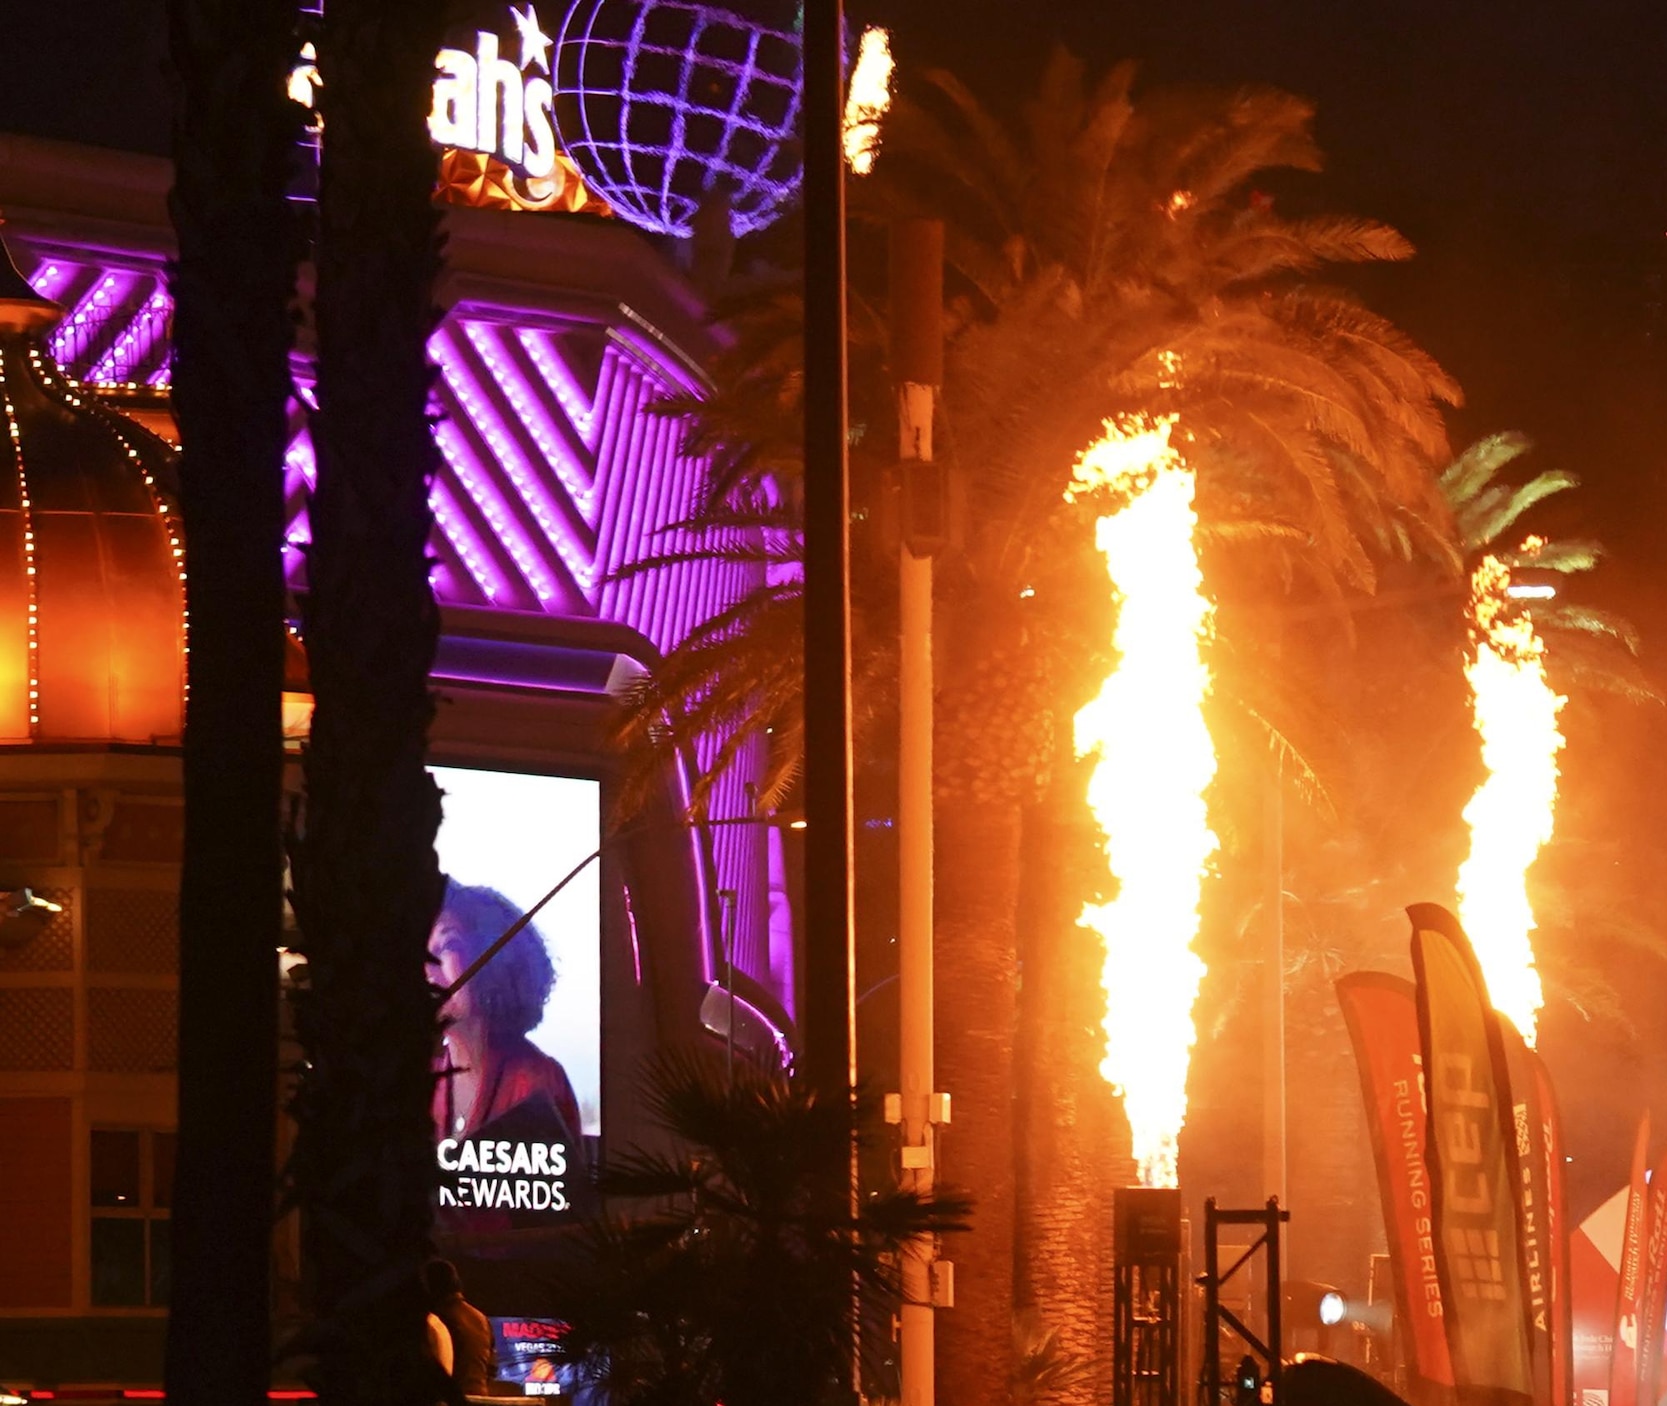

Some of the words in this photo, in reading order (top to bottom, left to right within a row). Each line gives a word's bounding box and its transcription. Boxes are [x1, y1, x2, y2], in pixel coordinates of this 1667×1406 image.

[437, 1138, 567, 1176] CAESARS
[1393, 1080, 1427, 1209] RUNNING
[1415, 1217, 1444, 1318] SERIES
[1521, 1166, 1548, 1332] AIRLINES
